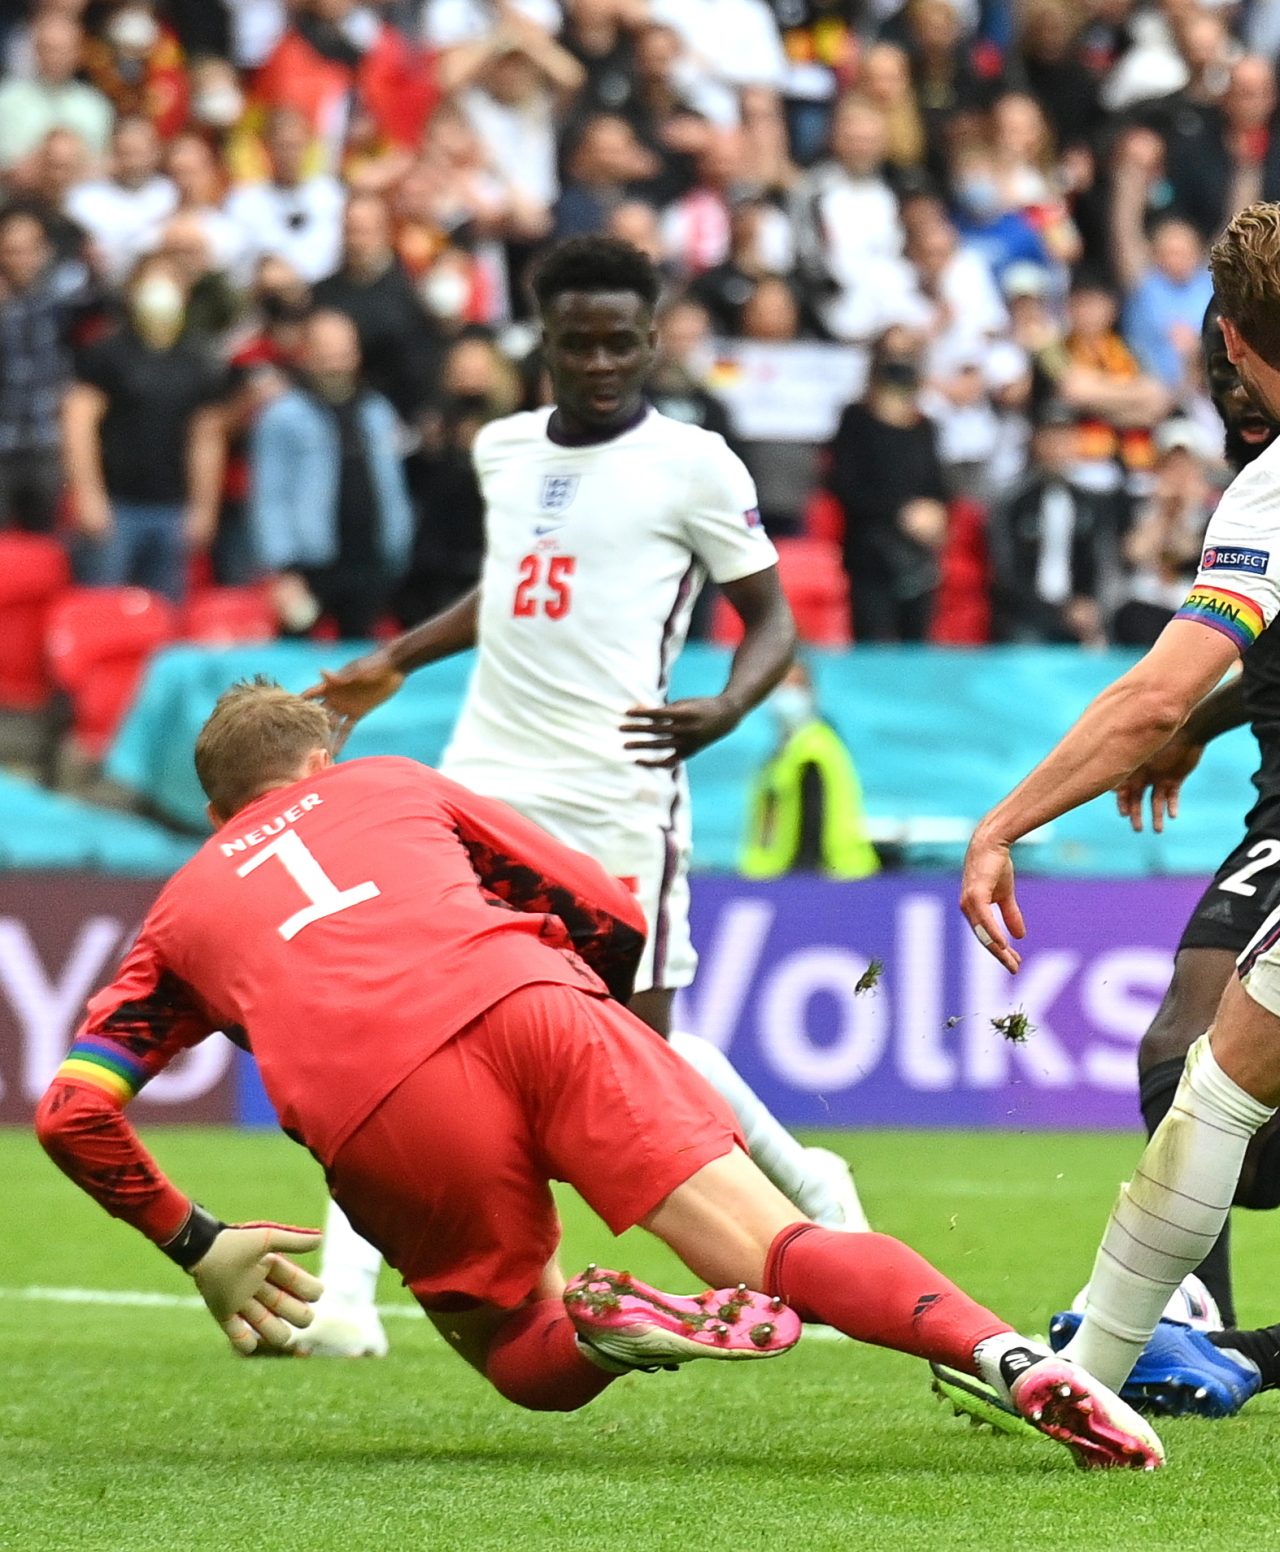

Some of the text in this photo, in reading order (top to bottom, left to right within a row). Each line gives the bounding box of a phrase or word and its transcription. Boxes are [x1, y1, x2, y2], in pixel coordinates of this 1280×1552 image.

[513, 554, 577, 621] 25
[1216, 552, 1268, 568] RESPECT
[219, 792, 324, 857] NEUER
[236, 828, 382, 942] 1
